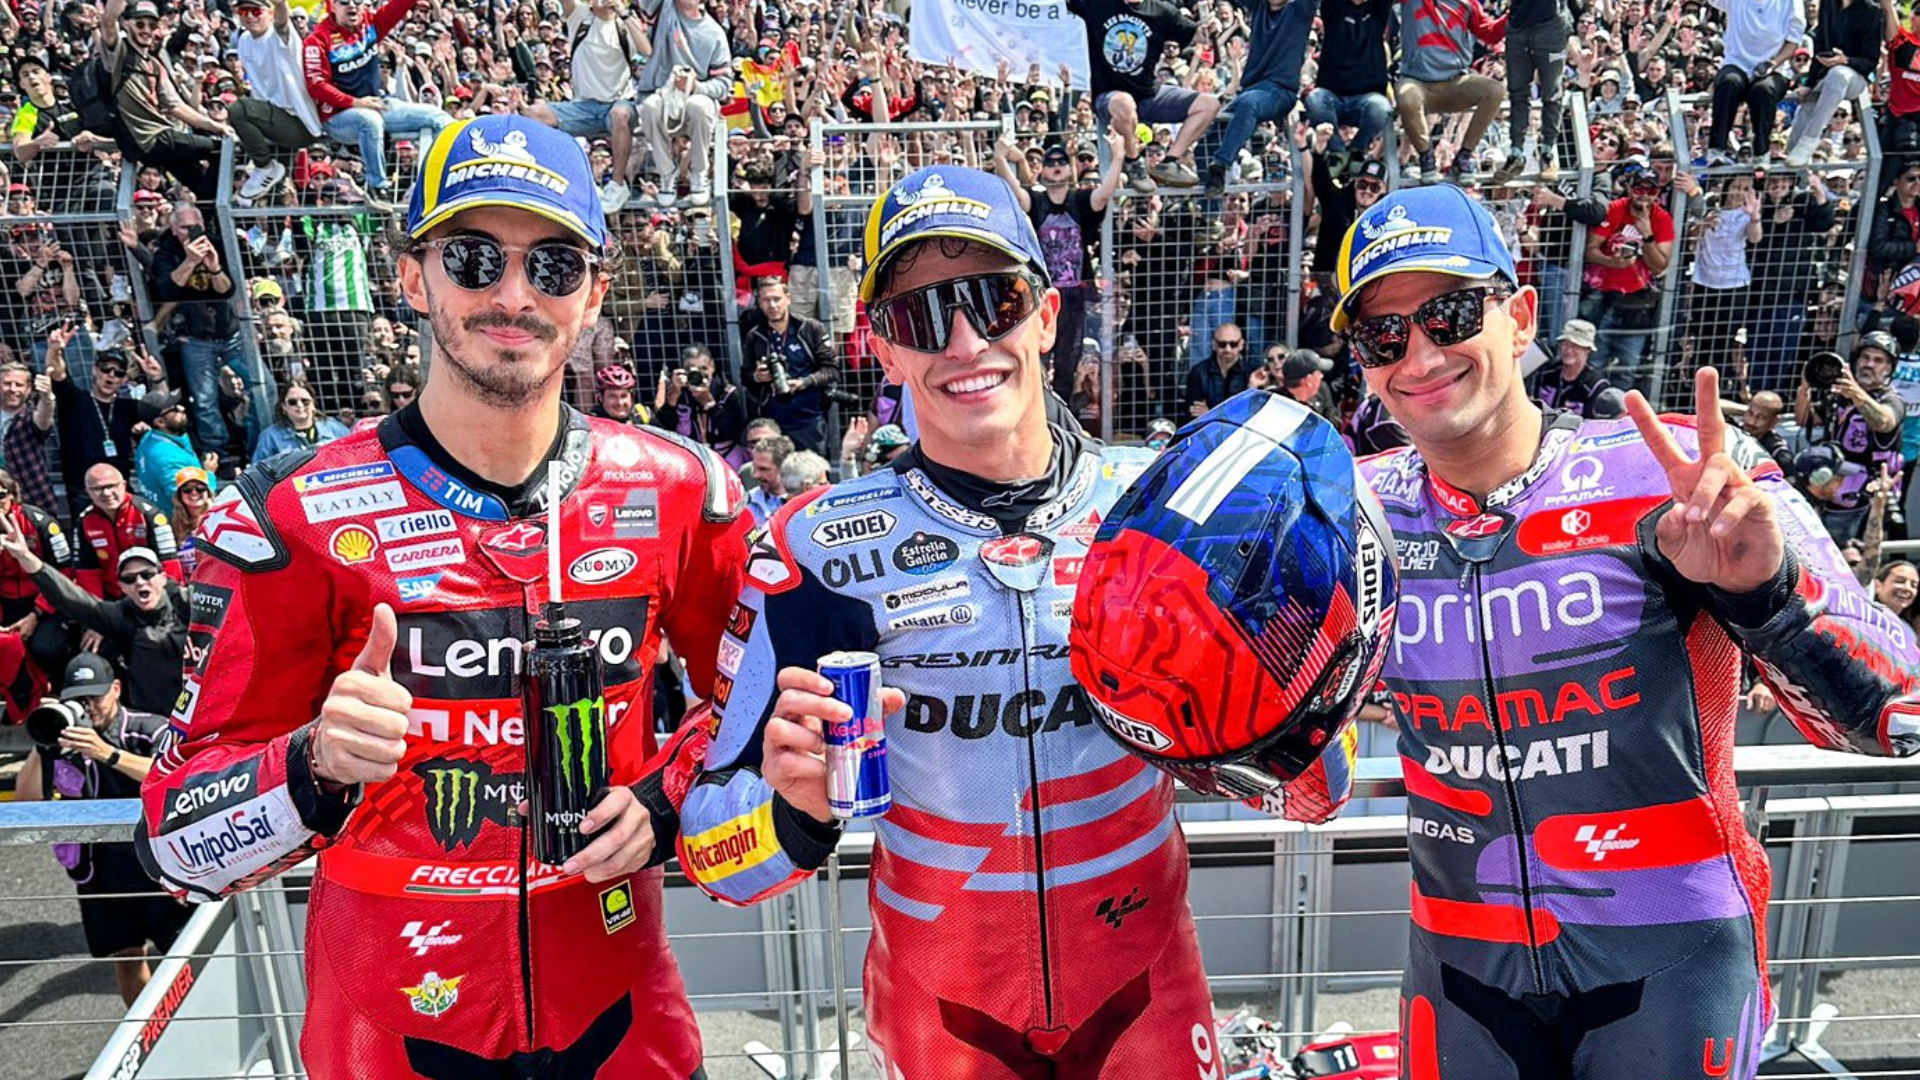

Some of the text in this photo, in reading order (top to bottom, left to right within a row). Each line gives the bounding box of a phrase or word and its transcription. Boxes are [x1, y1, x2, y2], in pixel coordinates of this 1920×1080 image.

[1015, 3, 1041, 19] be
[1047, 7, 1060, 19] a
[445, 163, 568, 195] MICHELIN
[882, 201, 991, 246] MICHELIN
[1352, 231, 1451, 280] MICHELIN
[323, 466, 385, 483] MICHELIN
[603, 470, 654, 481] motorola
[314, 490, 395, 514] EATALY
[444, 481, 484, 514] TIM
[833, 487, 894, 508] MICHELIN
[1544, 485, 1616, 506] PRAMAC
[400, 513, 451, 534] riello
[615, 508, 653, 519] Lenovo
[822, 514, 886, 543] SHOEI
[390, 544, 461, 564] CARRERA
[901, 541, 947, 557] Estrella
[906, 551, 948, 567] Galicia
[574, 557, 631, 573] SUOMY
[401, 580, 437, 598] SAP
[1361, 542, 1377, 625] SHOEI
[1394, 571, 1605, 665] prima
[408, 626, 633, 678] Leno
[880, 649, 1022, 669] GRESINI
[1392, 666, 1642, 732] PRAMAC
[904, 684, 1093, 740] DUCA
[829, 718, 862, 737] Red
[1425, 730, 1610, 781] DUCATI
[166, 773, 251, 822] Lenovo
[168, 805, 276, 872] UnipolSai
[141, 962, 194, 1053] PREMIER
